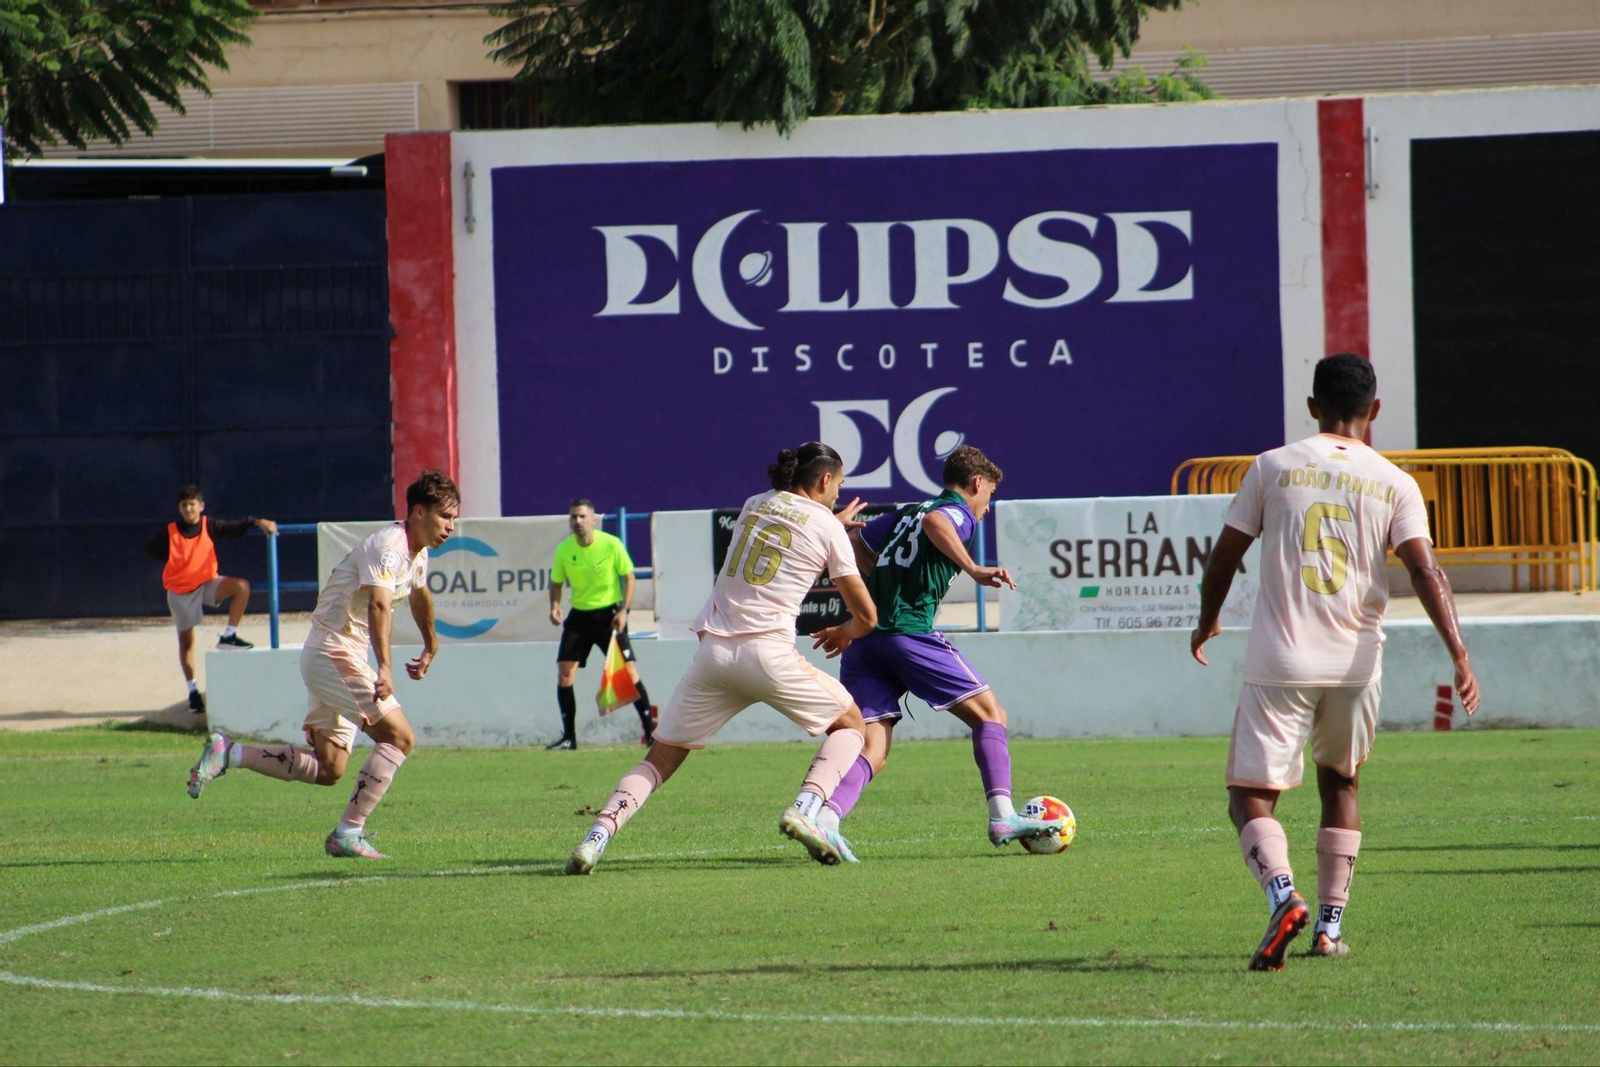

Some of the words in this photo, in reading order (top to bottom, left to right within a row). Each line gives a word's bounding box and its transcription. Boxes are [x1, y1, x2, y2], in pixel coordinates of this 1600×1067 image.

[592, 208, 1195, 331] ECLIPSE
[713, 339, 1073, 374] DISCOTECA
[1278, 462, 1331, 490] JOÃO
[1336, 471, 1396, 504] PAULO
[875, 511, 926, 568] 23
[1127, 512, 1159, 535] LA
[727, 514, 792, 586] 16
[1050, 536, 1247, 579] SERRAN
[1302, 502, 1352, 595] 5
[427, 570, 487, 594] OAL
[1106, 585, 1189, 597] HORTALIZAS
[1118, 616, 1142, 629] 605
[1146, 616, 1162, 628] 96
[1167, 615, 1182, 627] 72
